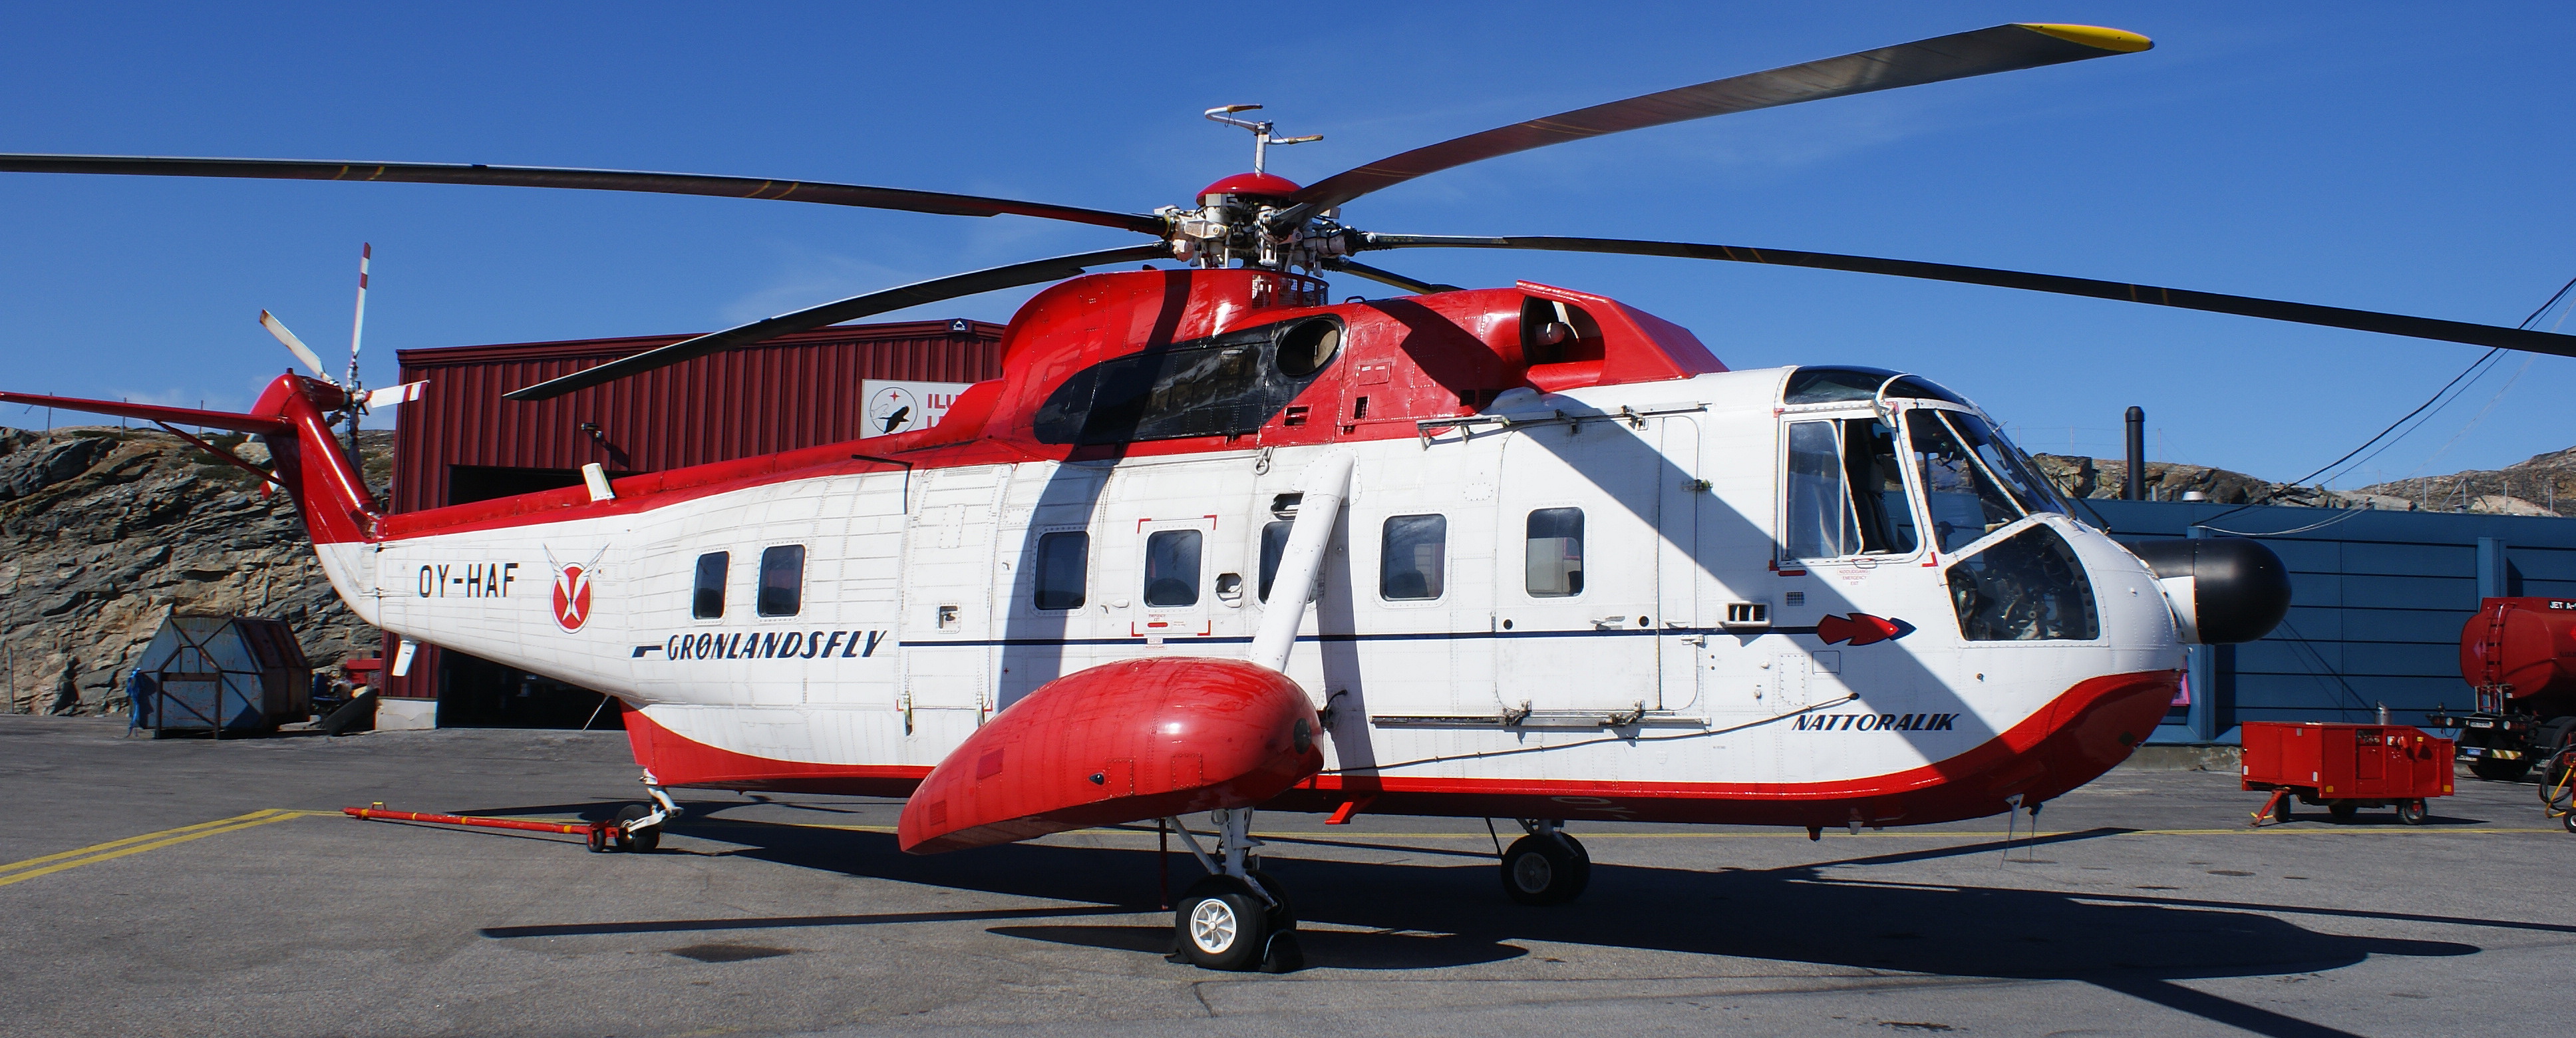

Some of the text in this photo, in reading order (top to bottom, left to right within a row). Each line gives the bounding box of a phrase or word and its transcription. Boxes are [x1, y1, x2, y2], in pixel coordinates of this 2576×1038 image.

[418, 562, 520, 598] OY-HAF
[668, 629, 887, 661] GRØNLANDSFLY
[1792, 713, 1959, 731] NATTORALIK
